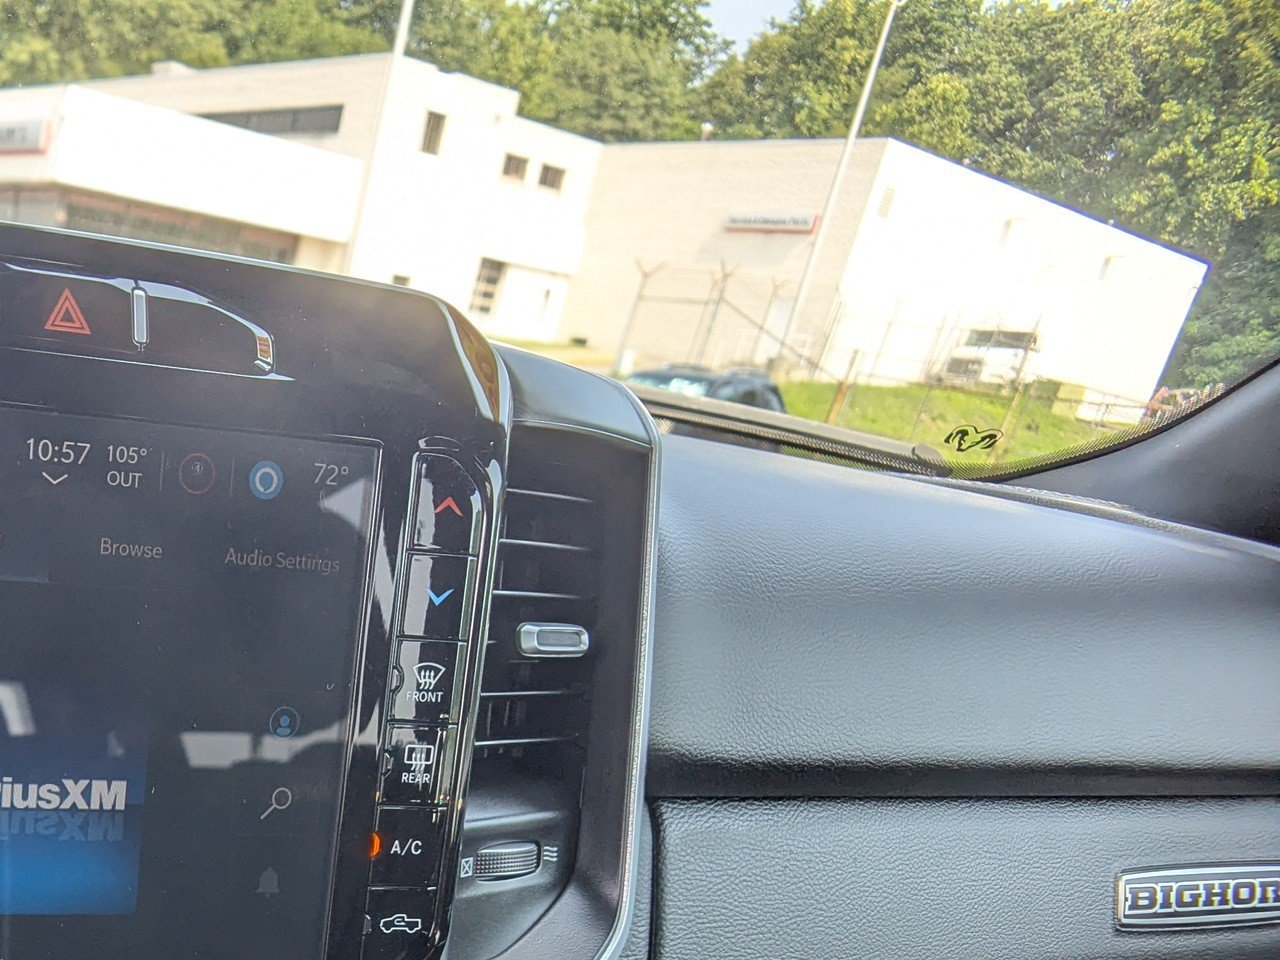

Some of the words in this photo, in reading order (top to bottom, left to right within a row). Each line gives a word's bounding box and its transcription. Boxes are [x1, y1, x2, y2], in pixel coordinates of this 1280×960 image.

[27, 438, 90, 464] 10:57
[107, 444, 147, 464] 105°
[107, 470, 142, 488] OUT
[314, 462, 349, 485] 72°
[100, 538, 163, 558] Browse
[224, 548, 272, 567] Audio
[275, 552, 340, 575] Settings
[406, 691, 443, 703] FRONT
[401, 772, 431, 784] REAR
[390, 840, 423, 855] A/C
